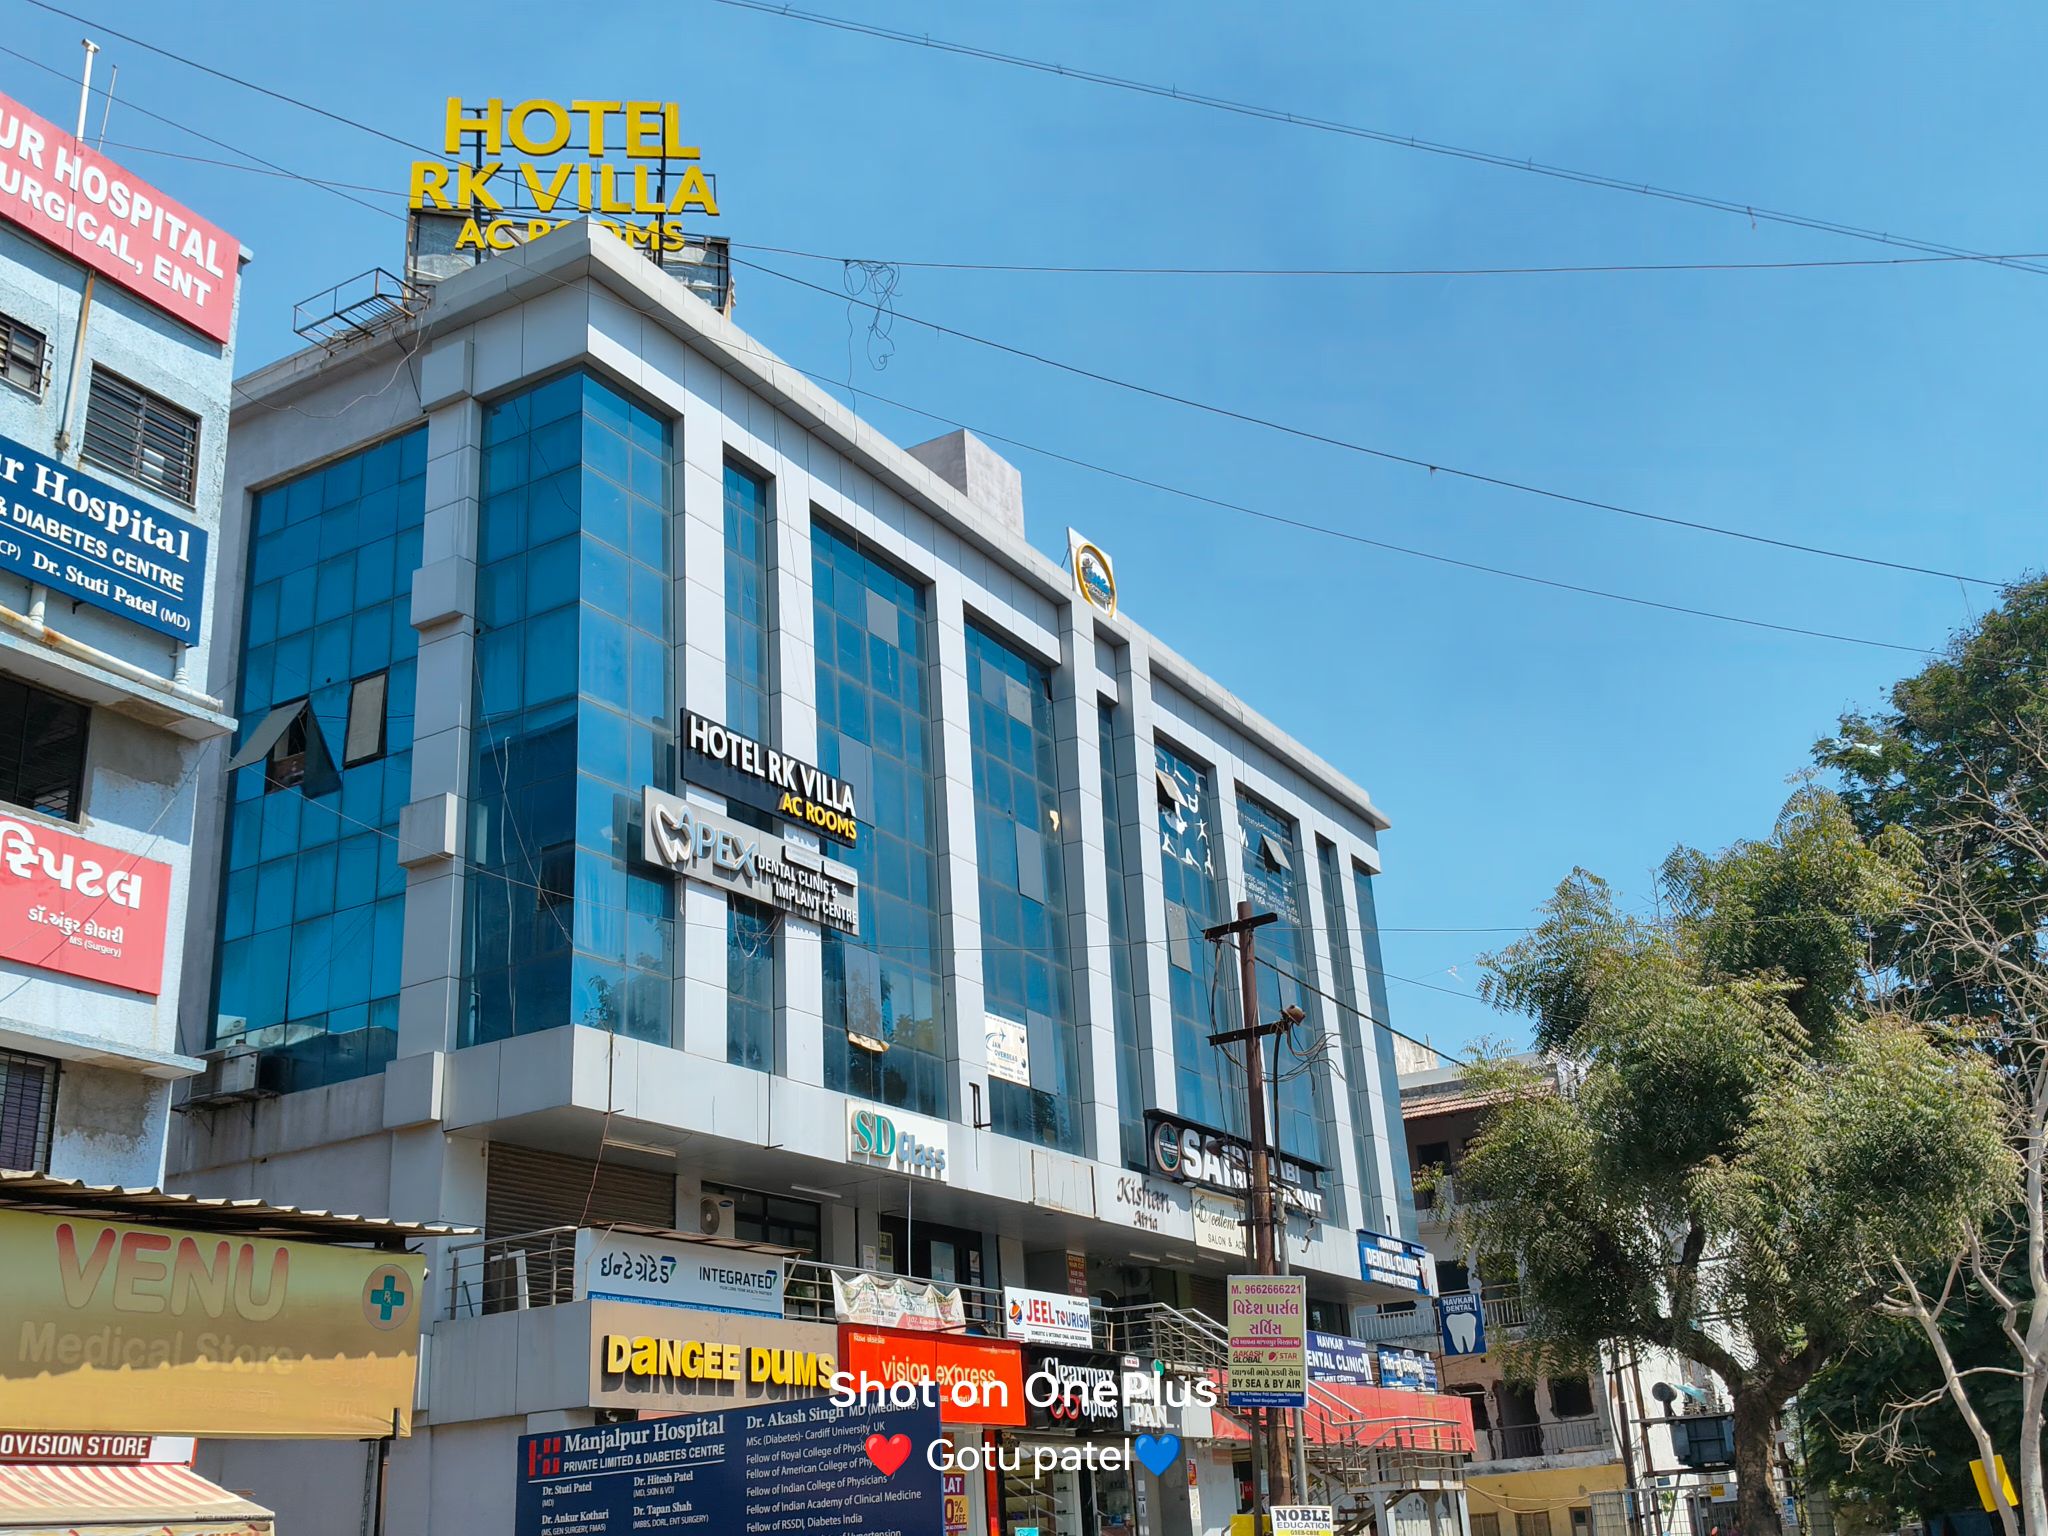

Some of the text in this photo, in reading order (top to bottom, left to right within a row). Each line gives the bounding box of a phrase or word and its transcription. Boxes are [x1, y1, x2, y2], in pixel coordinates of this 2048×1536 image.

[445, 97, 701, 159] HOTEL
[409, 161, 720, 216] RK VILLA
[54, 145, 224, 279] HOSPITAL
[455, 218, 516, 249] AC
[153, 254, 211, 307] ENT
[32, 462, 190, 563] Hospital
[13, 503, 185, 593] DIABETES CENTRE
[32, 551, 191, 632] Dr. Stuti Patel (MD)
[690, 715, 857, 817] HOTEL RK VILLA
[781, 792, 857, 841] AC ROOMS
[757, 854, 797, 883] DENTAL
[798, 870, 830, 895] CLINIC
[830, 882, 839, 898] &
[775, 881, 857, 927] IMPLANT CENTRE
[852, 1110, 896, 1158] SD
[1116, 1176, 1172, 1214] Kishan
[1207, 1233, 1226, 1248] SALON
[1377, 1237, 1403, 1253] NAVKAR
[56, 1223, 289, 1322] VENU
[1364, 1248, 1394, 1270] DENTAL
[1393, 1255, 1420, 1276] CLINIC
[699, 1266, 773, 1290] INTEGRATED
[1370, 1269, 1396, 1286] IMPLANT
[1231, 1285, 1301, 1295] M. 9662666221
[1443, 1296, 1474, 1305] NAVKAR
[1026, 1298, 1090, 1330] JEEL TOURISM
[1233, 1299, 1299, 1315] વિદેશ પાર્સલ
[1445, 1304, 1473, 1312] DENTAL
[18, 1321, 294, 1374] Medical Store
[1233, 1350, 1264, 1358] AAKASH
[1316, 1335, 1344, 1351] NAVKAR
[1280, 1352, 1297, 1360] STAR
[1336, 1354, 1365, 1374] CLINIC
[882, 1355, 997, 1388] vision express
[1044, 1357, 1115, 1387] Clearmax
[1232, 1378, 1301, 1389] BY SEA & BY AIR
[746, 1415, 765, 1429] Dr.
[767, 1408, 807, 1427] Akash
[809, 1406, 845, 1423] Singh
[849, 1405, 865, 1417] MD
[0, 1434, 149, 1457] OVISION STORE
[564, 1415, 725, 1454] Manjalpur Hospital
[746, 1436, 762, 1447] MSc
[805, 1427, 831, 1440] Cardiff
[831, 1424, 871, 1437] University
[873, 1420, 885, 1432] UK
[564, 1444, 725, 1472] PRIVATE LIMITED & DIABETES CENTRE
[746, 1444, 841, 1464] Fellow of Royal College of
[633, 1470, 694, 1487] Dr. Hitesh Patel
[746, 1468, 771, 1479] Fellow
[771, 1466, 781, 1477] of
[781, 1464, 817, 1475] American
[818, 1459, 848, 1472] College
[849, 1457, 858, 1468] of
[542, 1481, 592, 1496] Dr. Stuti Patel
[746, 1475, 887, 1497] Fellow of Indian College of Physicians
[633, 1500, 692, 1517] Dr. Tapan Shah
[746, 1489, 922, 1515] Fellow of Indian Academy of Clinical Medicine
[542, 1508, 609, 1524] Dr. Ankur Kothari
[669, 1514, 709, 1526] ENT SURGERY)
[746, 1513, 863, 1533] Fellow of Diabetes India
[955, 1514, 966, 1523] OFF
[1275, 1509, 1330, 1522] NOBLE
[552, 1526, 564, 1535] GEN
